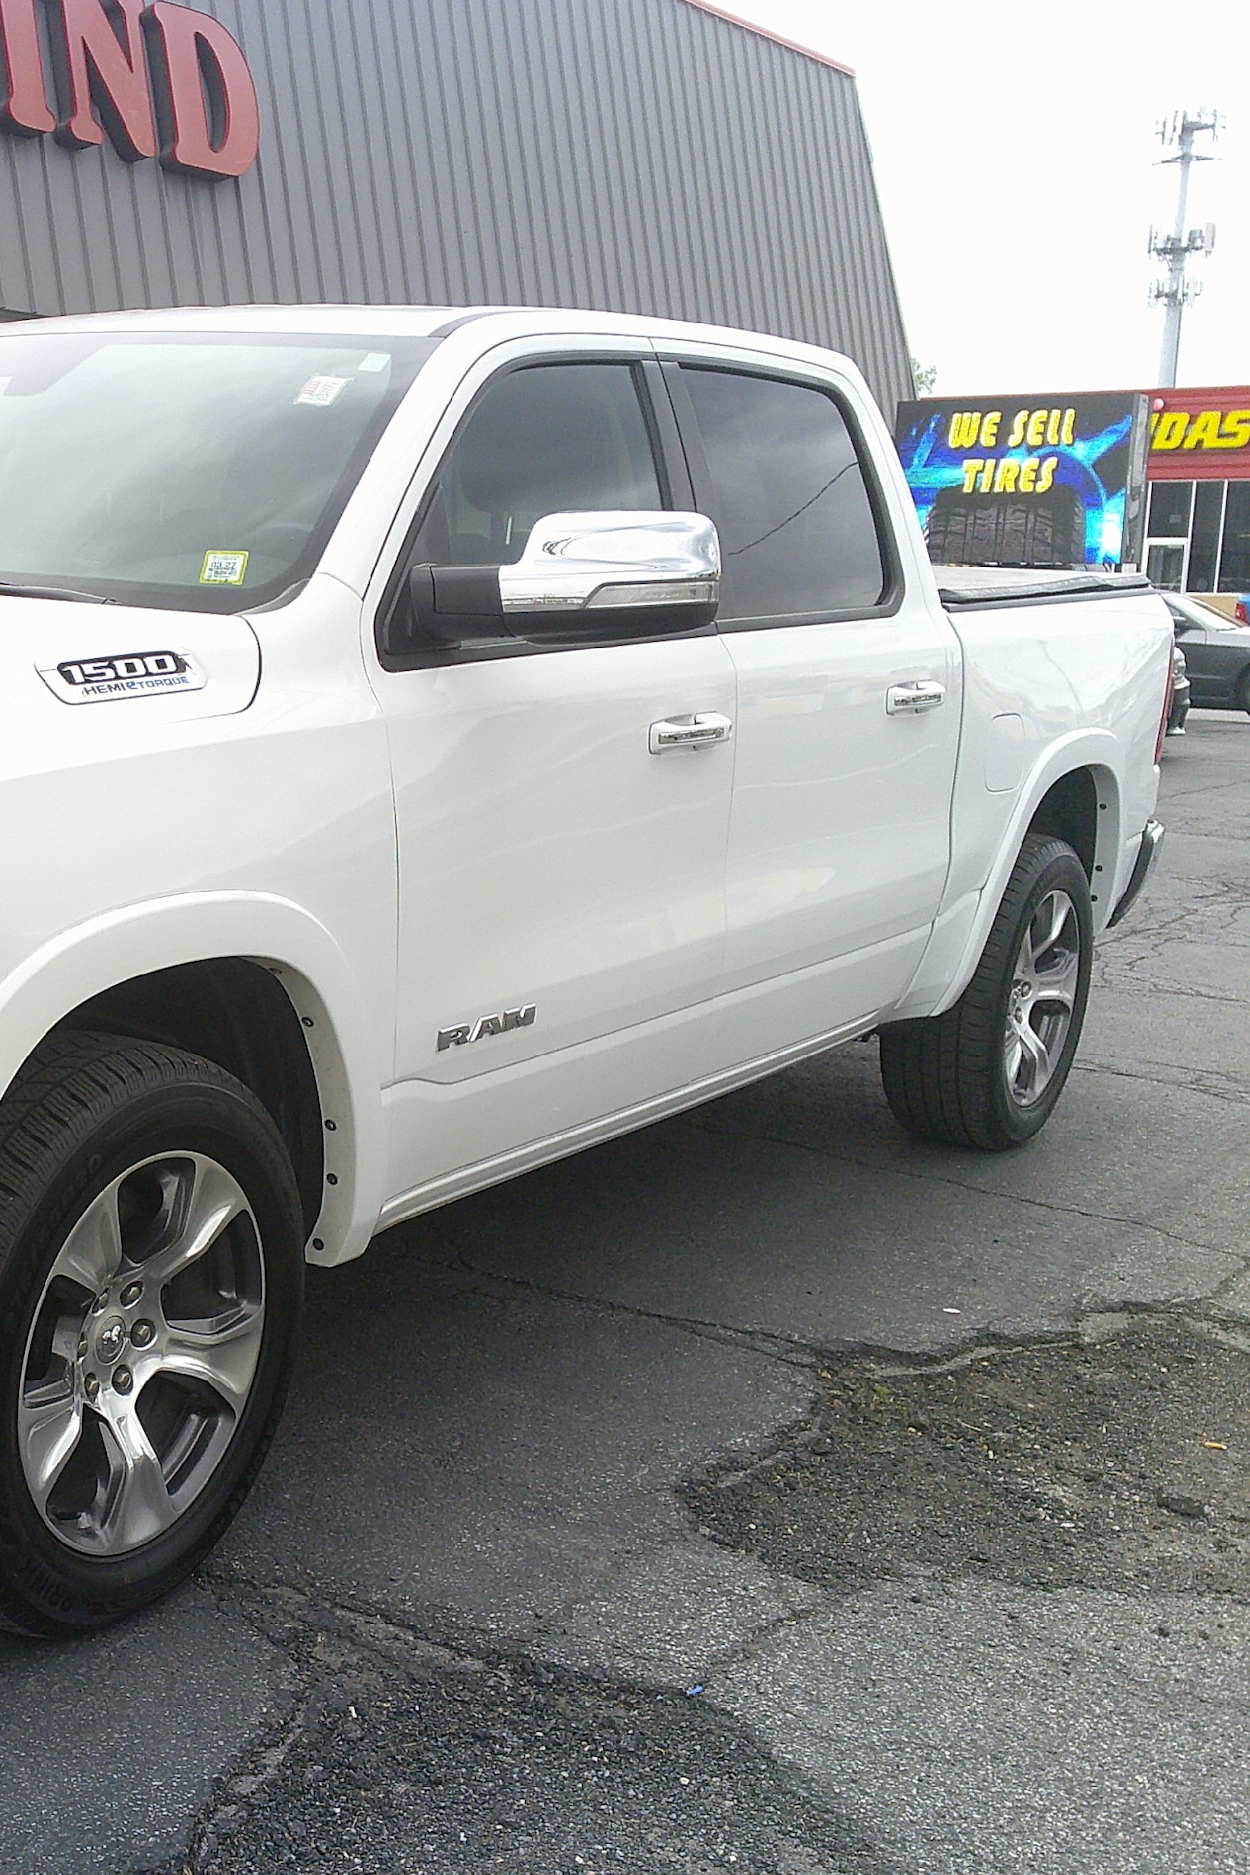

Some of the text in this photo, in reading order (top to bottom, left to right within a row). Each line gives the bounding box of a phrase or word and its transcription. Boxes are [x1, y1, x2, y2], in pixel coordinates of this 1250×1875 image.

[948, 408, 1076, 449] WE SELL
[961, 457, 1058, 493] TIRES
[61, 654, 178, 684] 1500
[83, 683, 126, 696] HEMI
[436, 1002, 536, 1052] RAM
